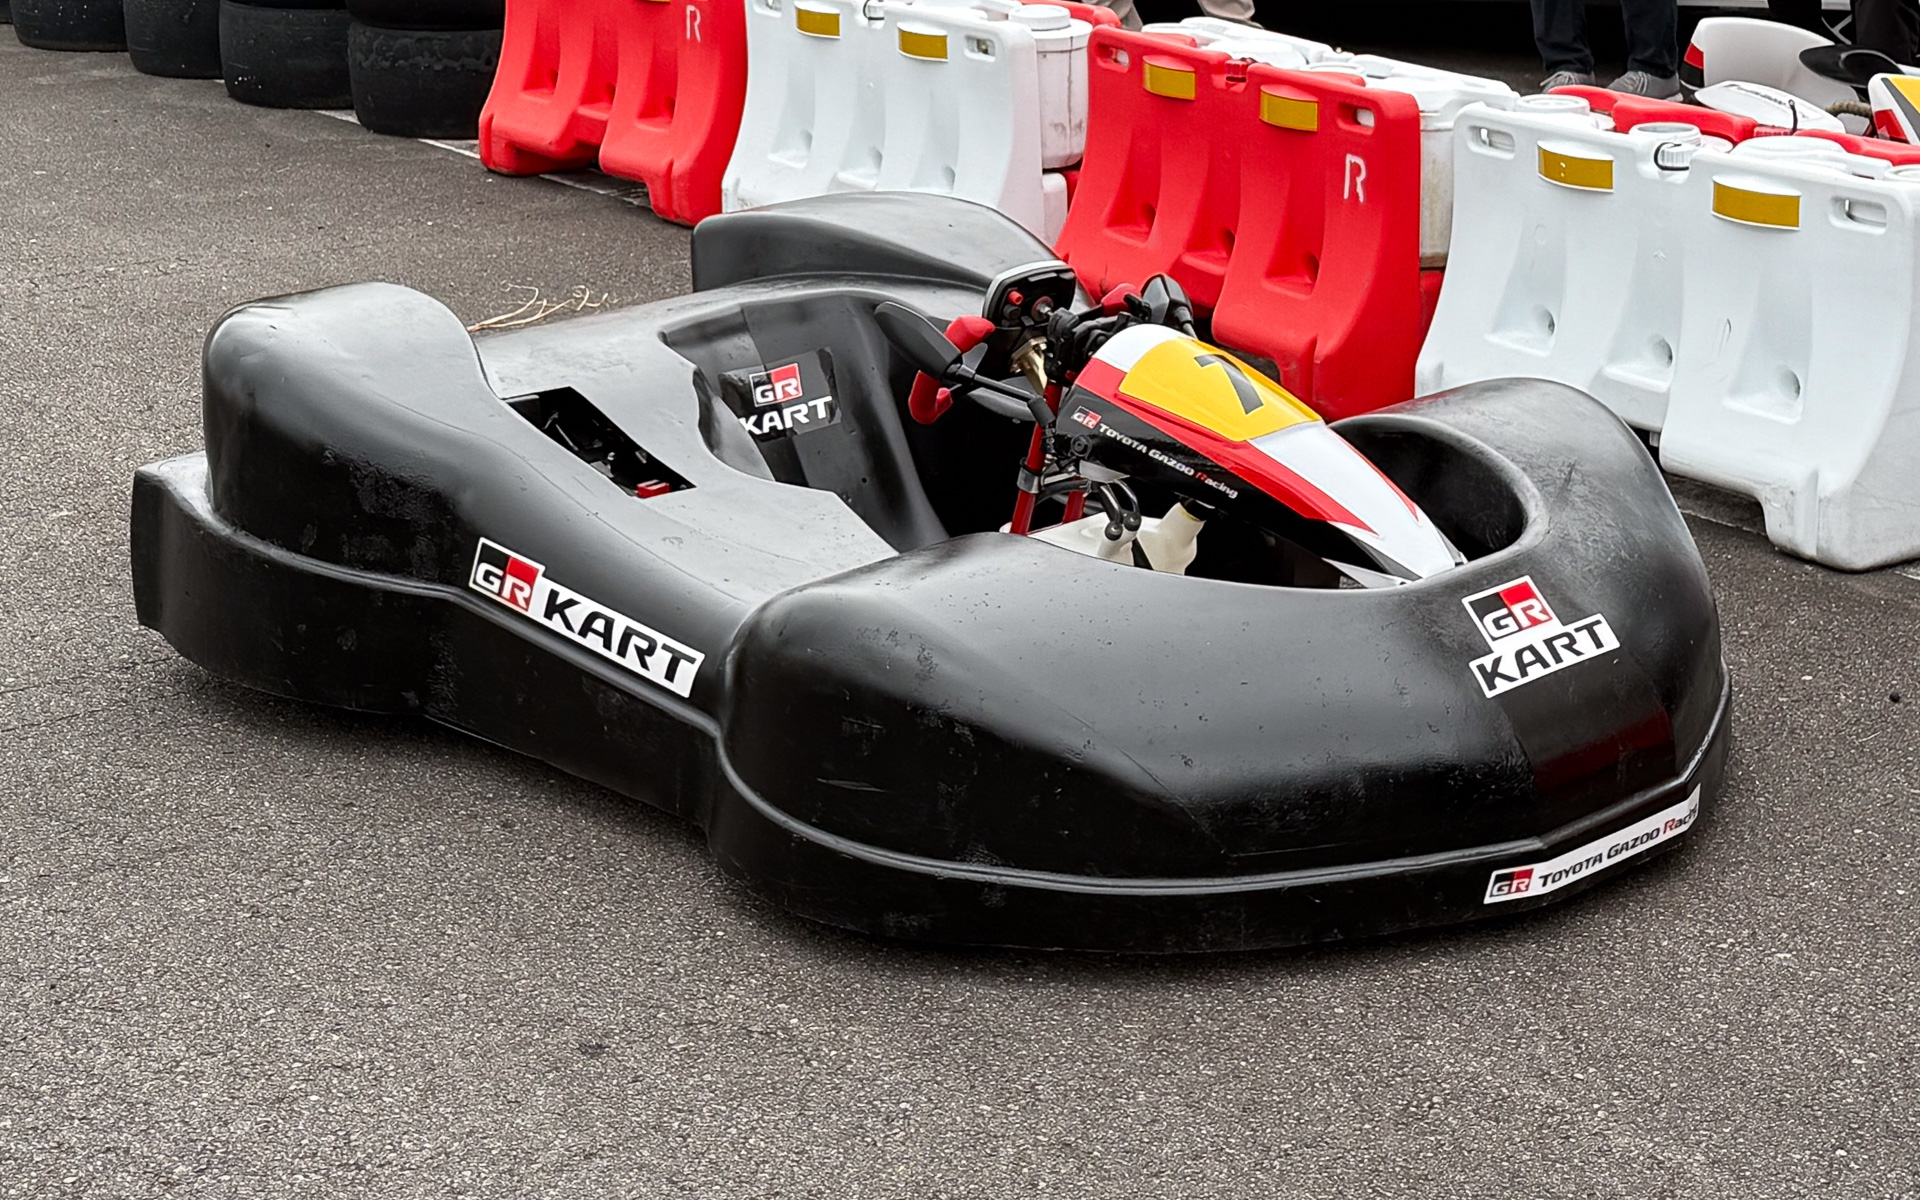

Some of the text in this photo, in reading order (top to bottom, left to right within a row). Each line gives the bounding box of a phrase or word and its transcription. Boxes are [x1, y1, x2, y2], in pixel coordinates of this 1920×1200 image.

[1344, 153, 1367, 203] R
[739, 395, 832, 435] KART
[755, 378, 799, 403] GR
[1194, 354, 1264, 415] 7
[1099, 423, 1147, 453] TOYOTA
[1148, 448, 1195, 476] GAZOO
[1195, 472, 1238, 499] Racing
[475, 562, 696, 684] GR KART
[1482, 597, 1550, 638] GR
[1476, 619, 1604, 691] KART
[1493, 879, 1529, 894] GR
[1538, 852, 1602, 887] TOYOTA
[1606, 827, 1660, 860] GAZOO
